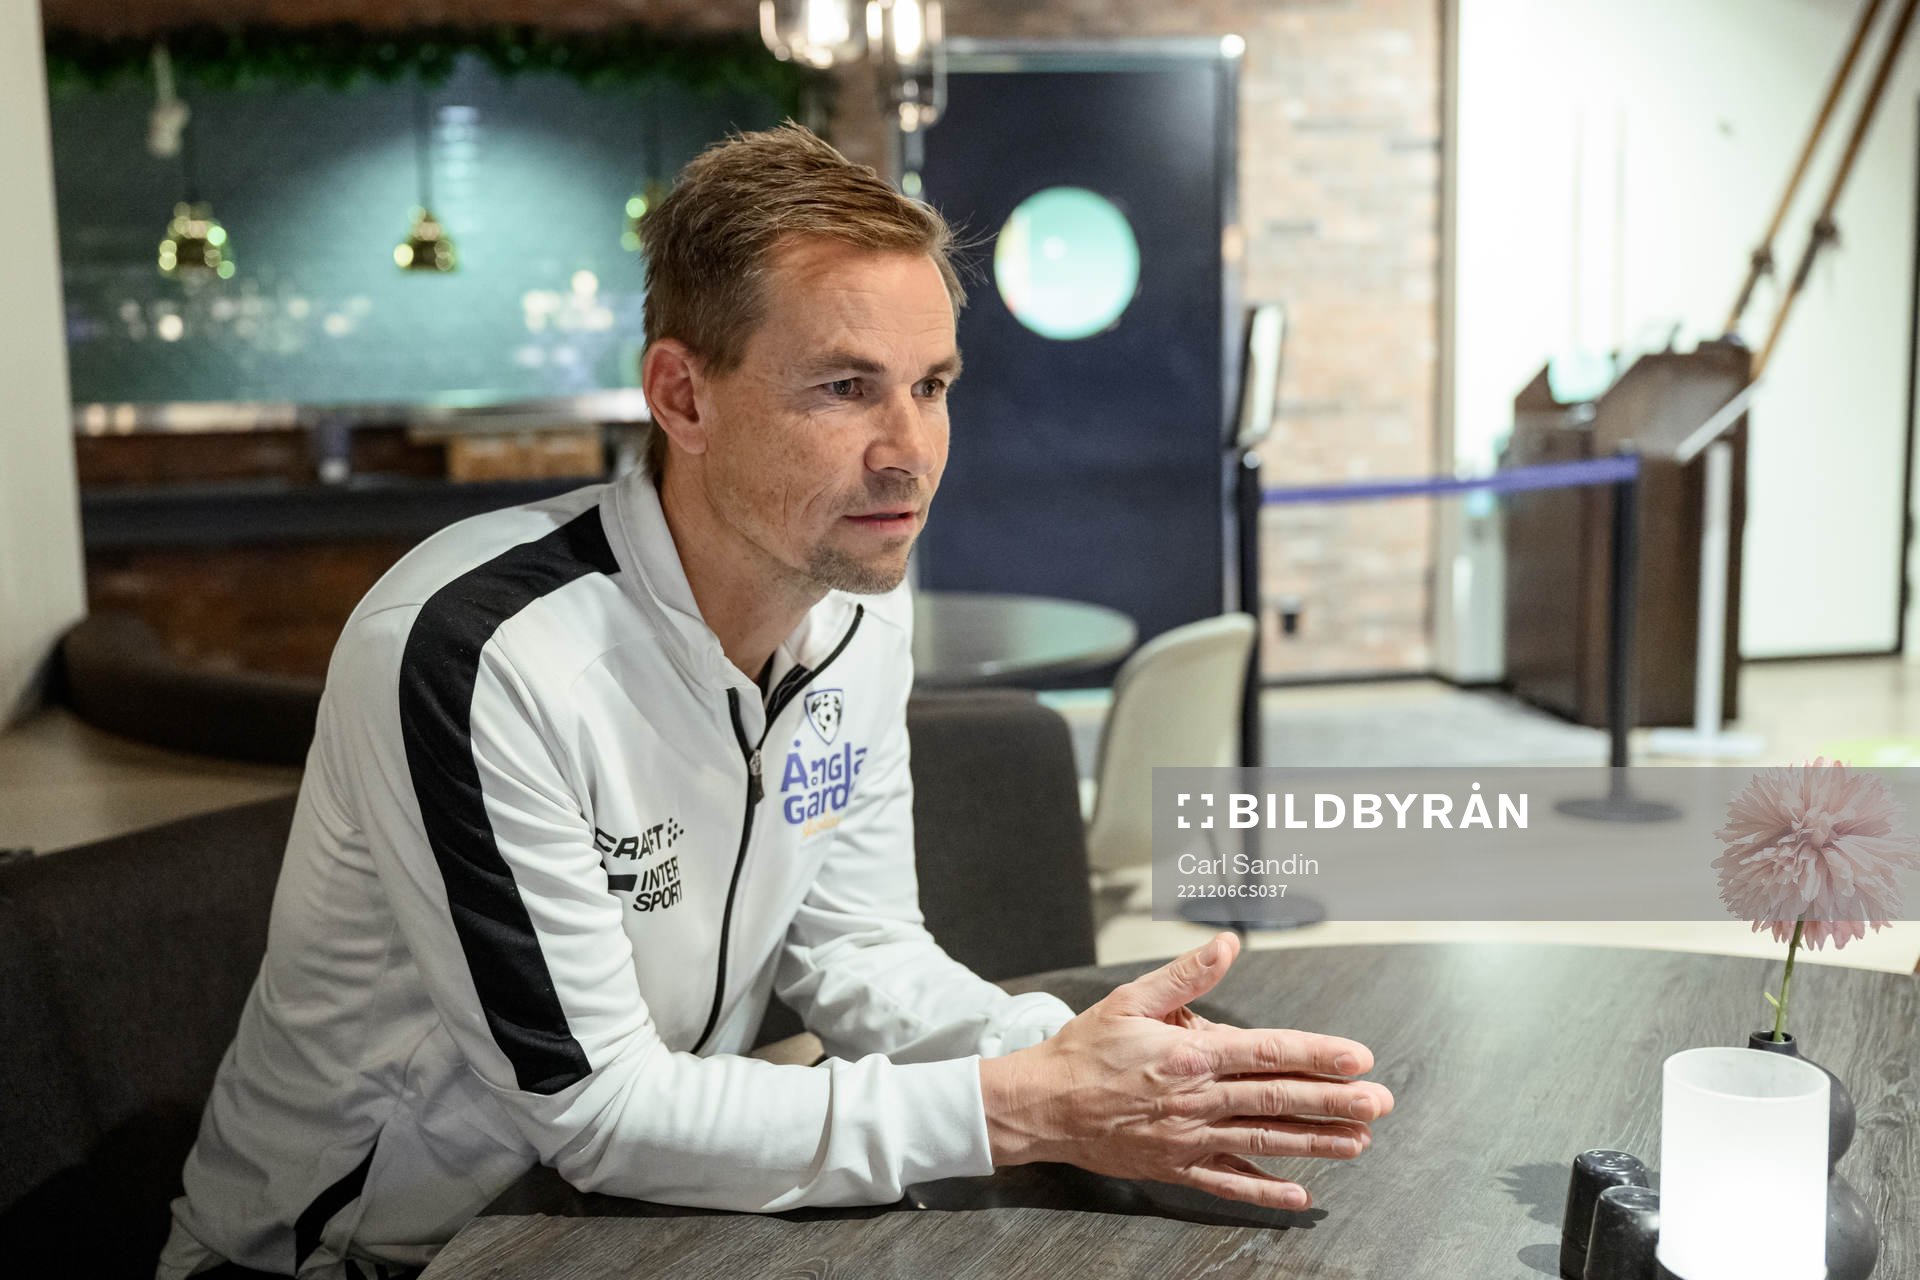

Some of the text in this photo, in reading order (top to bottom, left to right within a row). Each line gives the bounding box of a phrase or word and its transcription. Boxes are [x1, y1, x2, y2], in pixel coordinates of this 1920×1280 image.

[595, 823, 664, 861] CRAFT
[641, 855, 680, 892] INTER
[632, 879, 683, 913] SPORT
